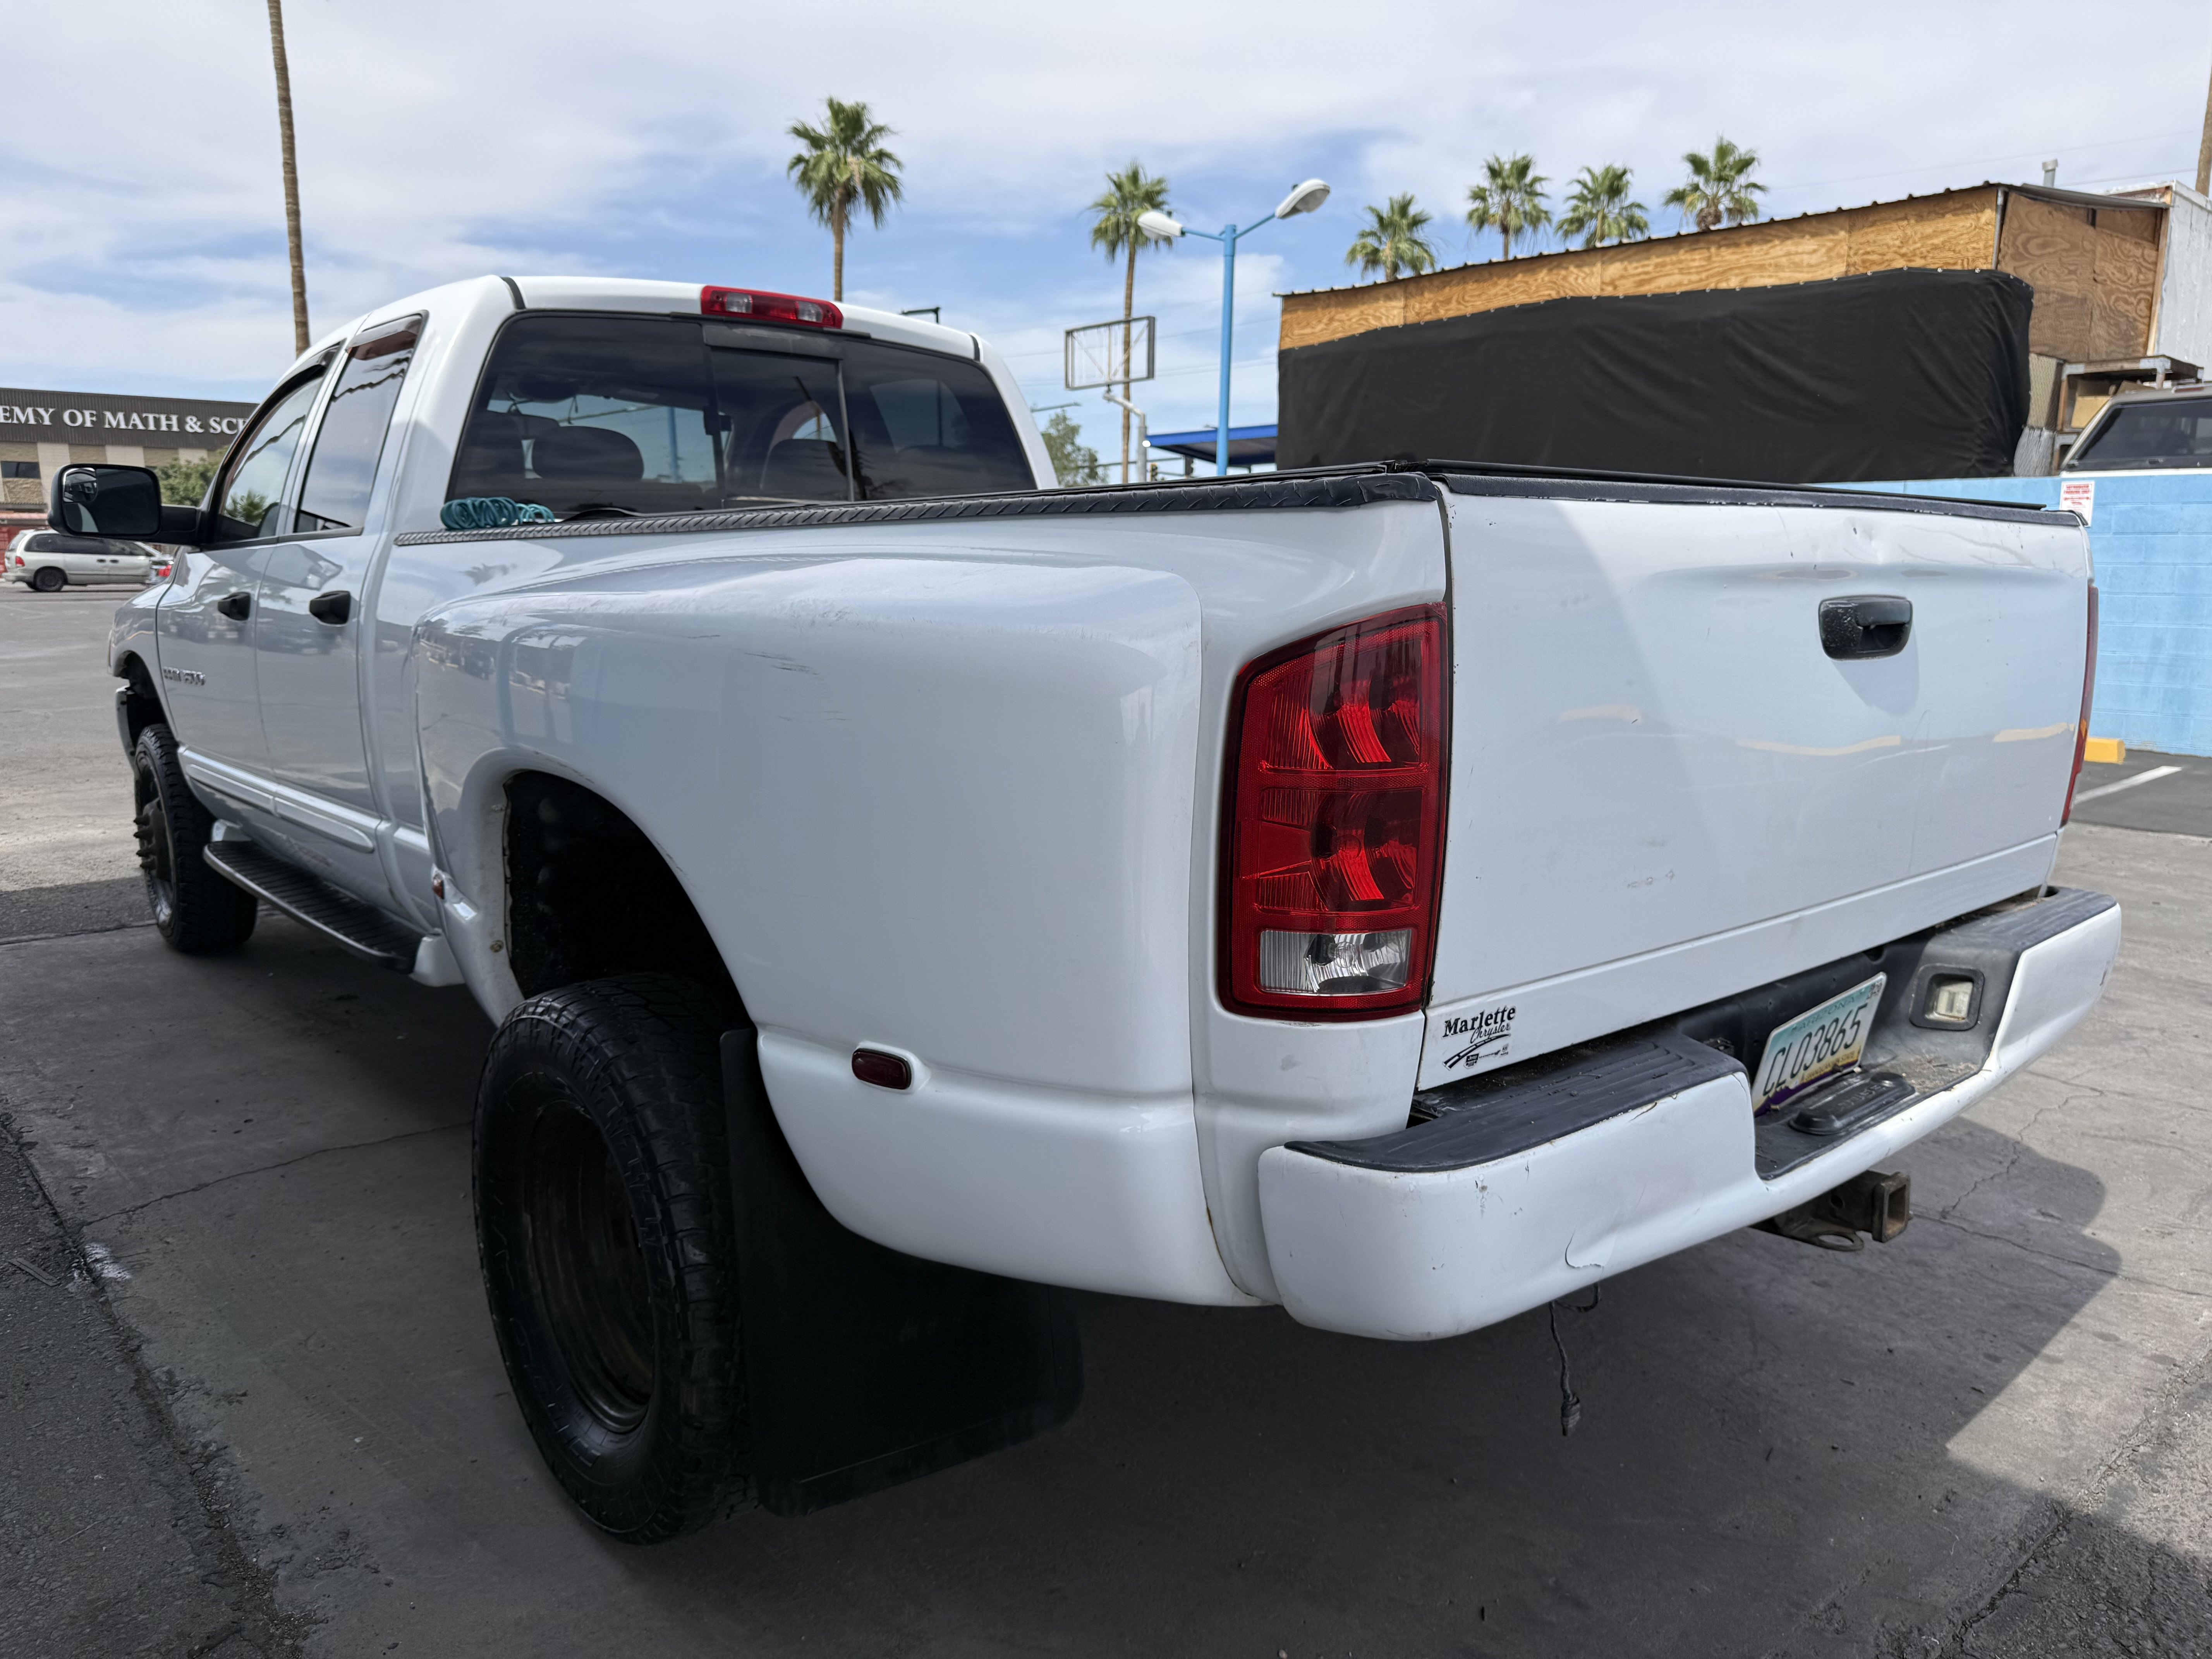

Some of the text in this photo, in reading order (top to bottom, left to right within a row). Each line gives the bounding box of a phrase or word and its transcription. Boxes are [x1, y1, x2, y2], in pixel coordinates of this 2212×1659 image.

[0, 405, 56, 426] EMY
[63, 409, 97, 428] OF
[103, 410, 180, 432] MATH
[185, 416, 204, 433] &
[1442, 1006, 1516, 1037] Marlette
[1470, 1023, 1511, 1044] Chrysler
[1762, 1003, 1868, 1096] CL03865
